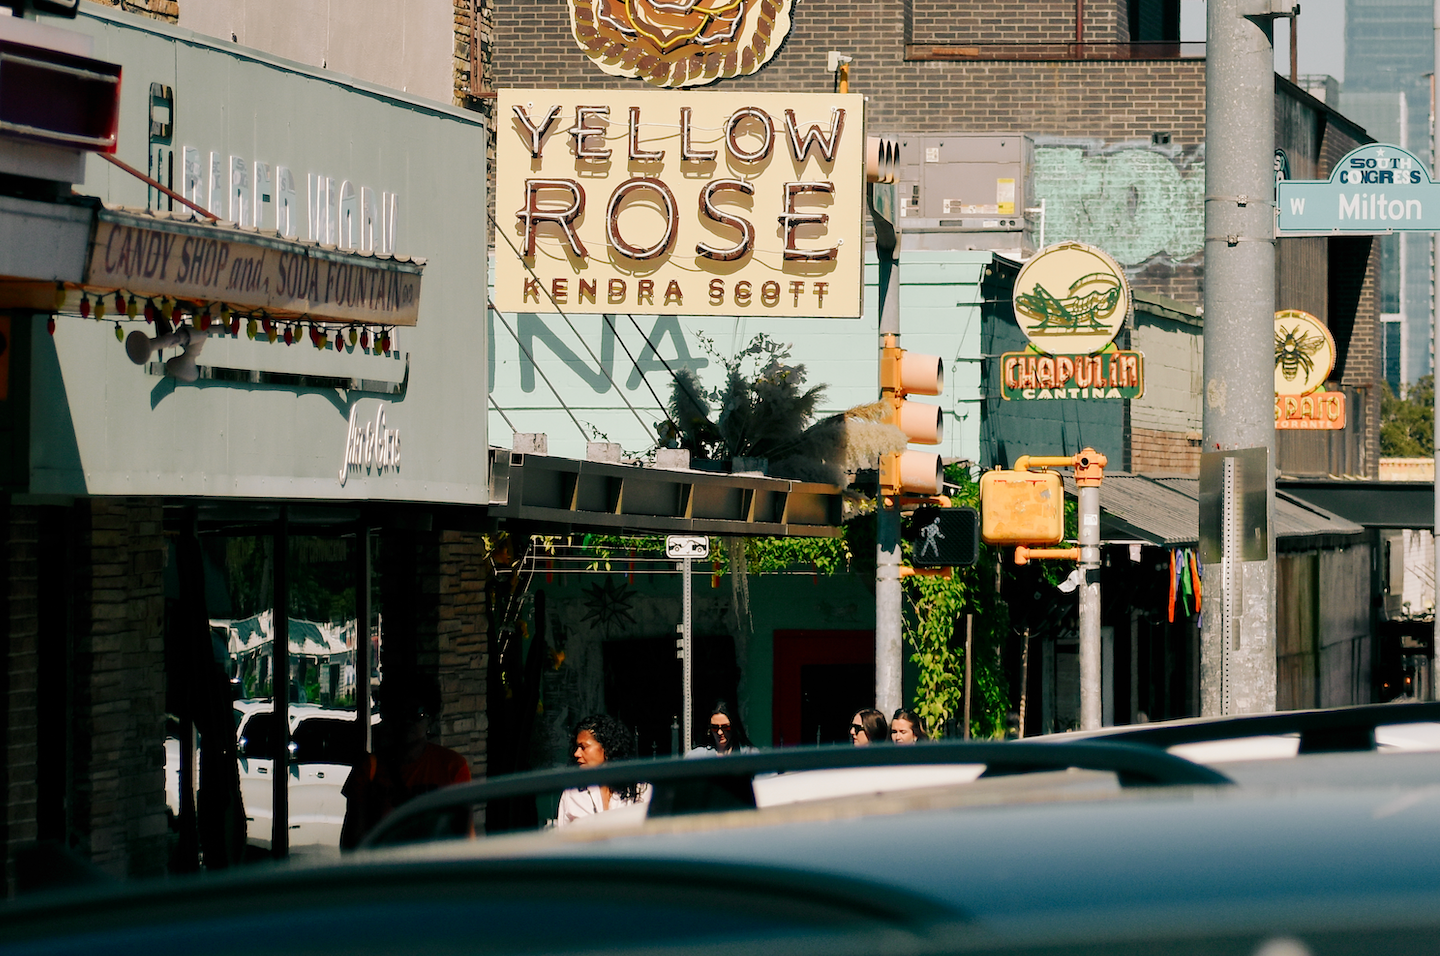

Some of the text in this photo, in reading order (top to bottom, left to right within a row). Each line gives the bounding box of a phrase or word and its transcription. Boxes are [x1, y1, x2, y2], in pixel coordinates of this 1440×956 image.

[511, 105, 847, 162] YELLOW
[1340, 170, 1421, 184] CONGRESS
[1350, 158, 1412, 169] SOUTH
[516, 177, 838, 260] ROSE
[1290, 197, 1305, 215] W
[1338, 193, 1422, 220] Milton
[105, 223, 178, 281] CANDY
[177, 235, 229, 287] SHOP
[276, 252, 319, 302] SODA
[325, 262, 401, 313] FOUNTAIN
[523, 277, 830, 304] KENDRA SCOTT
[1022, 388, 1122, 399] CANTINA
